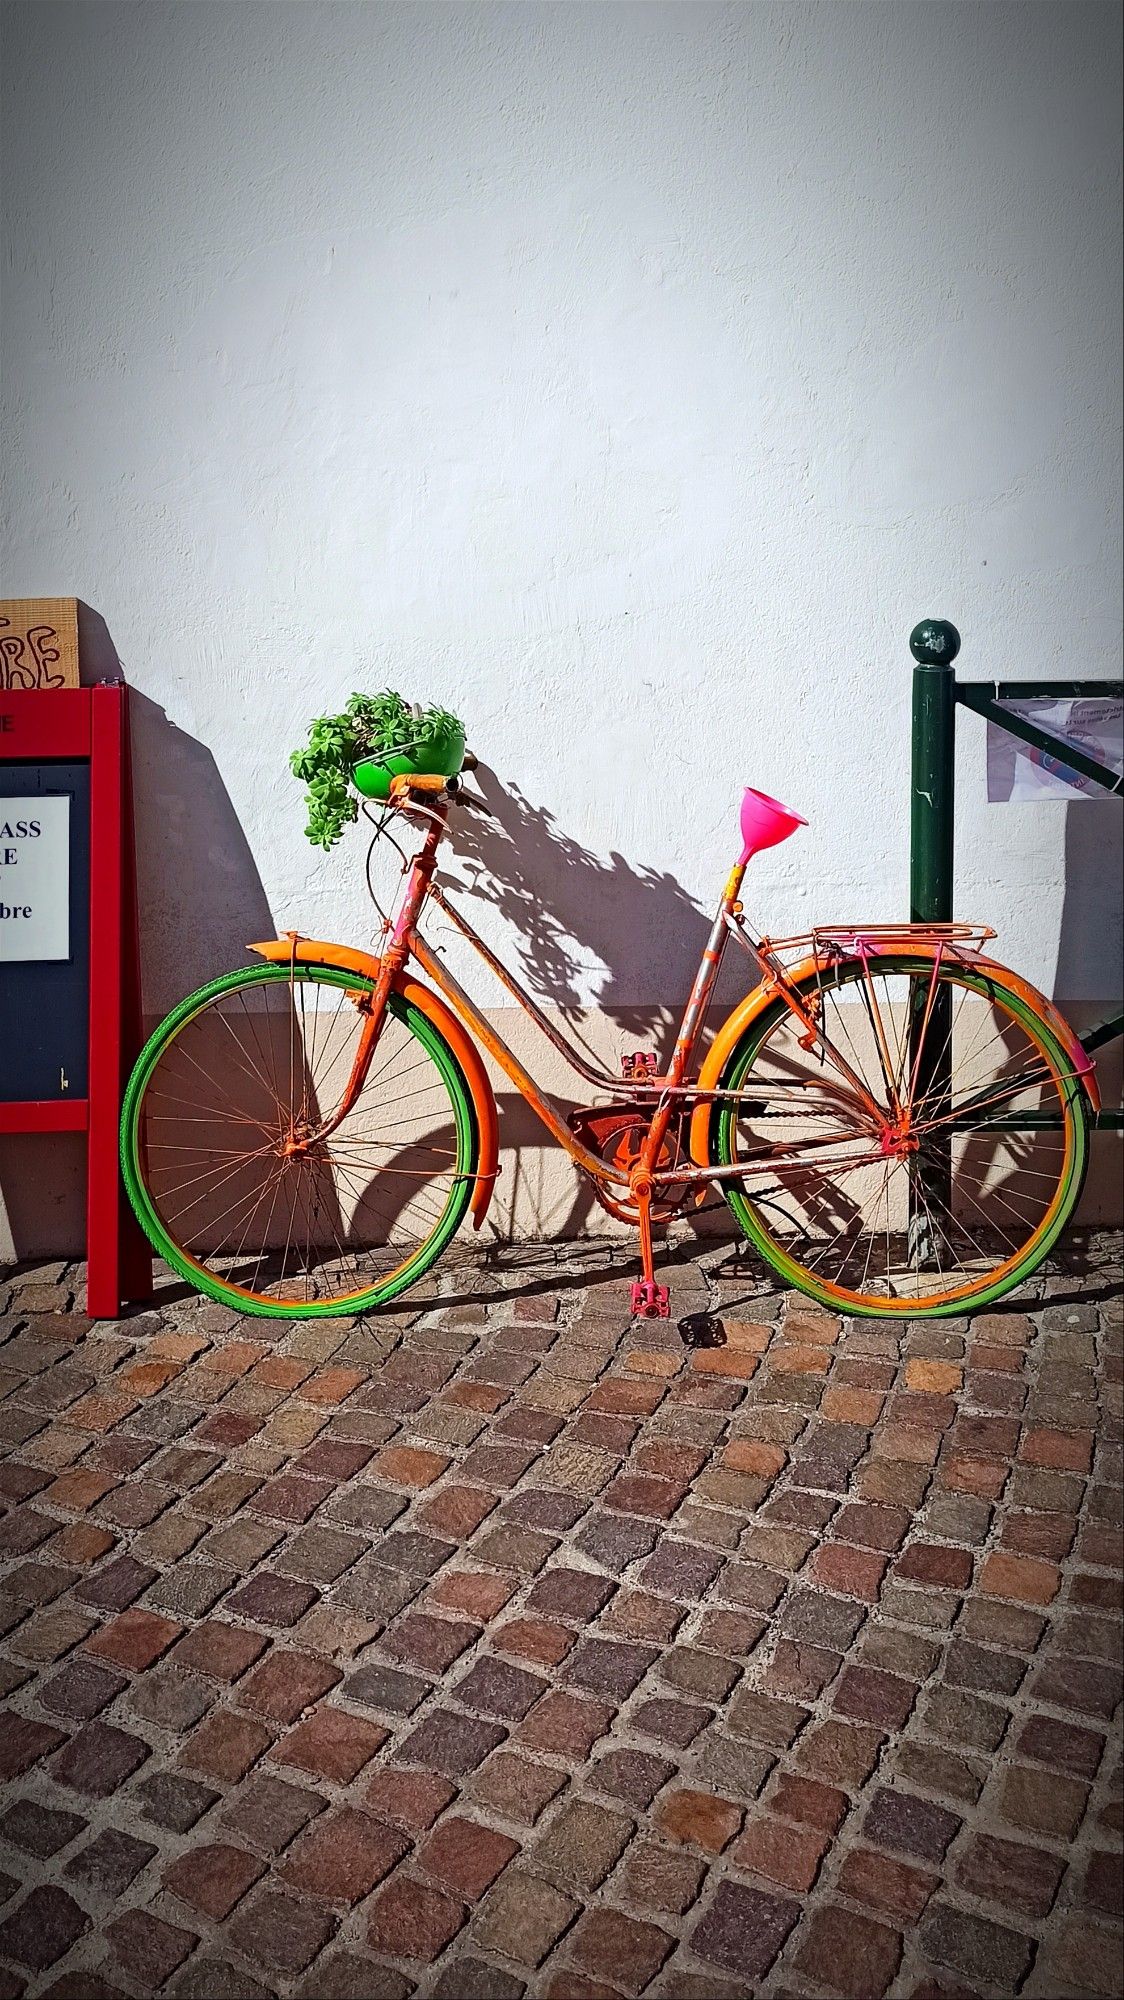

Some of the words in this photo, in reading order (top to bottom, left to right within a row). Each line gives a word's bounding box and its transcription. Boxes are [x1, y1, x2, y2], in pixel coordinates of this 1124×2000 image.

[0, 625, 65, 689] RE
[0, 820, 41, 838] ASS
[0, 848, 18, 865] E
[0, 902, 32, 919] bre
